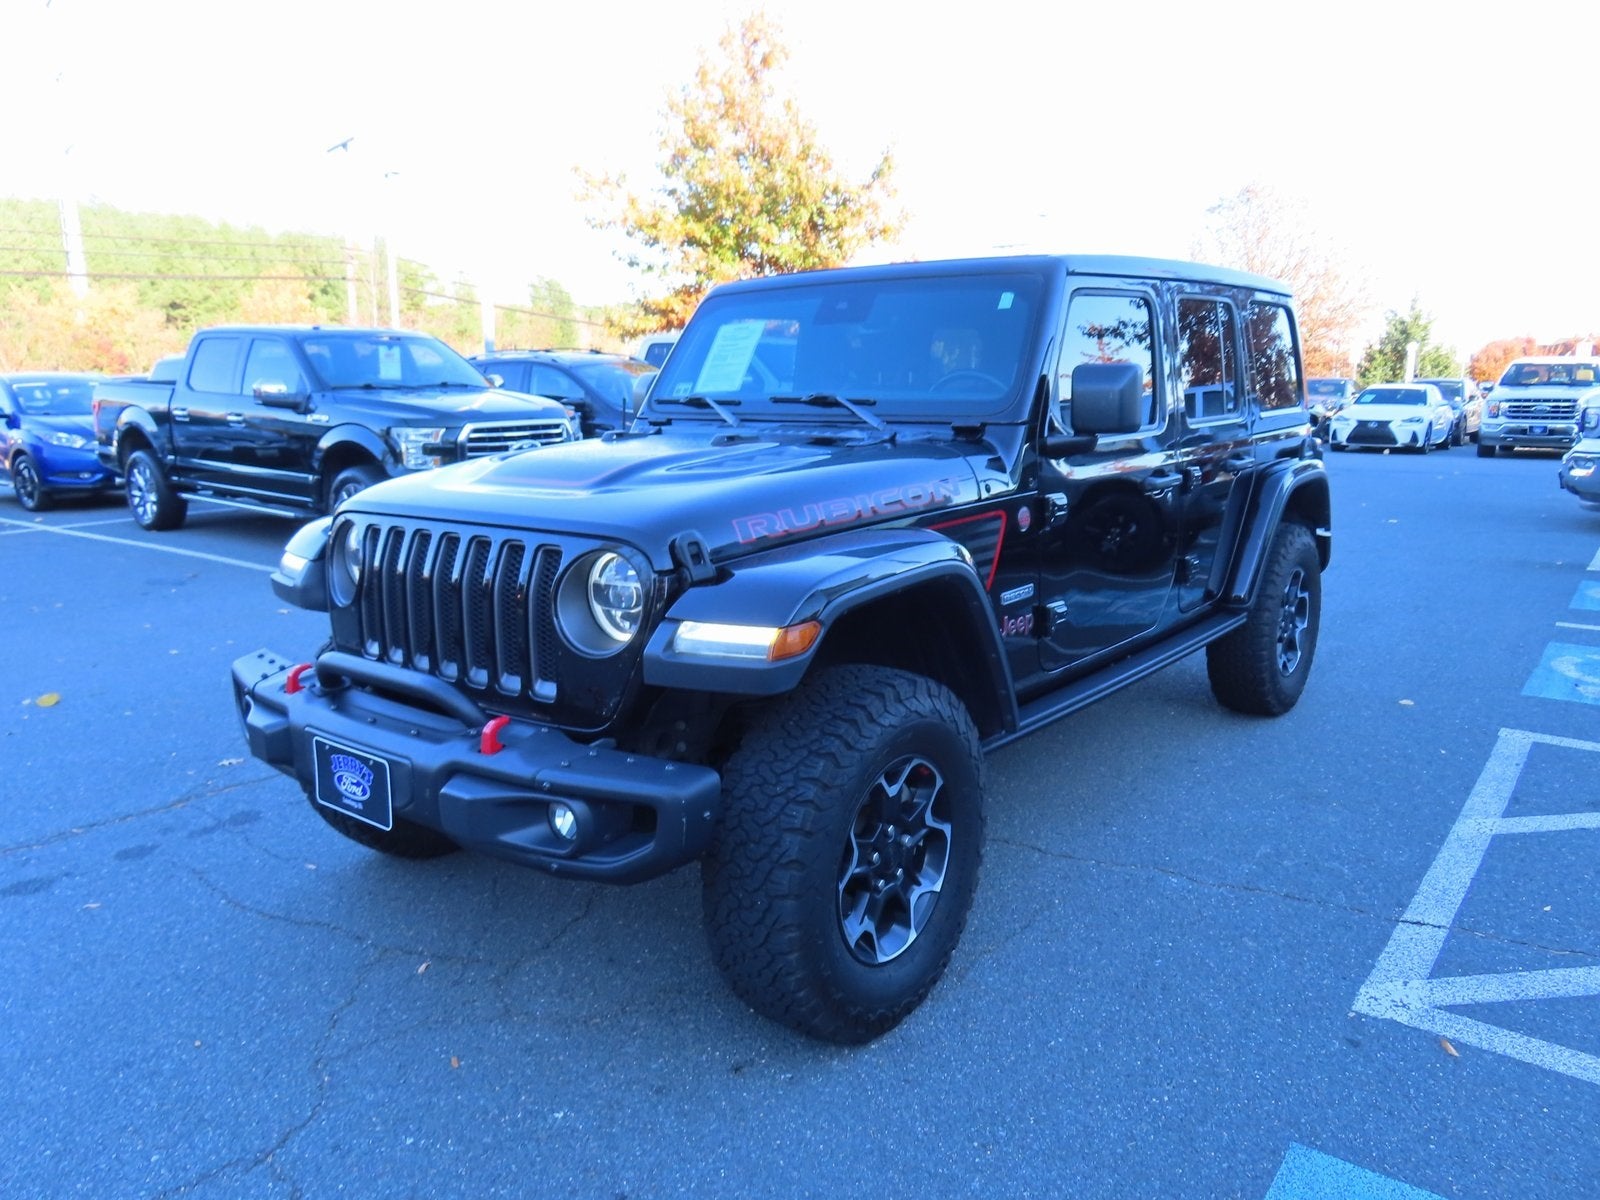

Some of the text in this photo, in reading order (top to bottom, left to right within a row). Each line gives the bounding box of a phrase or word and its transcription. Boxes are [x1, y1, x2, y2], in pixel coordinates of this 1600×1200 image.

[732, 477, 961, 544] RUBICON
[1000, 613, 1033, 637] Jeep
[341, 774, 364, 796] Ford
